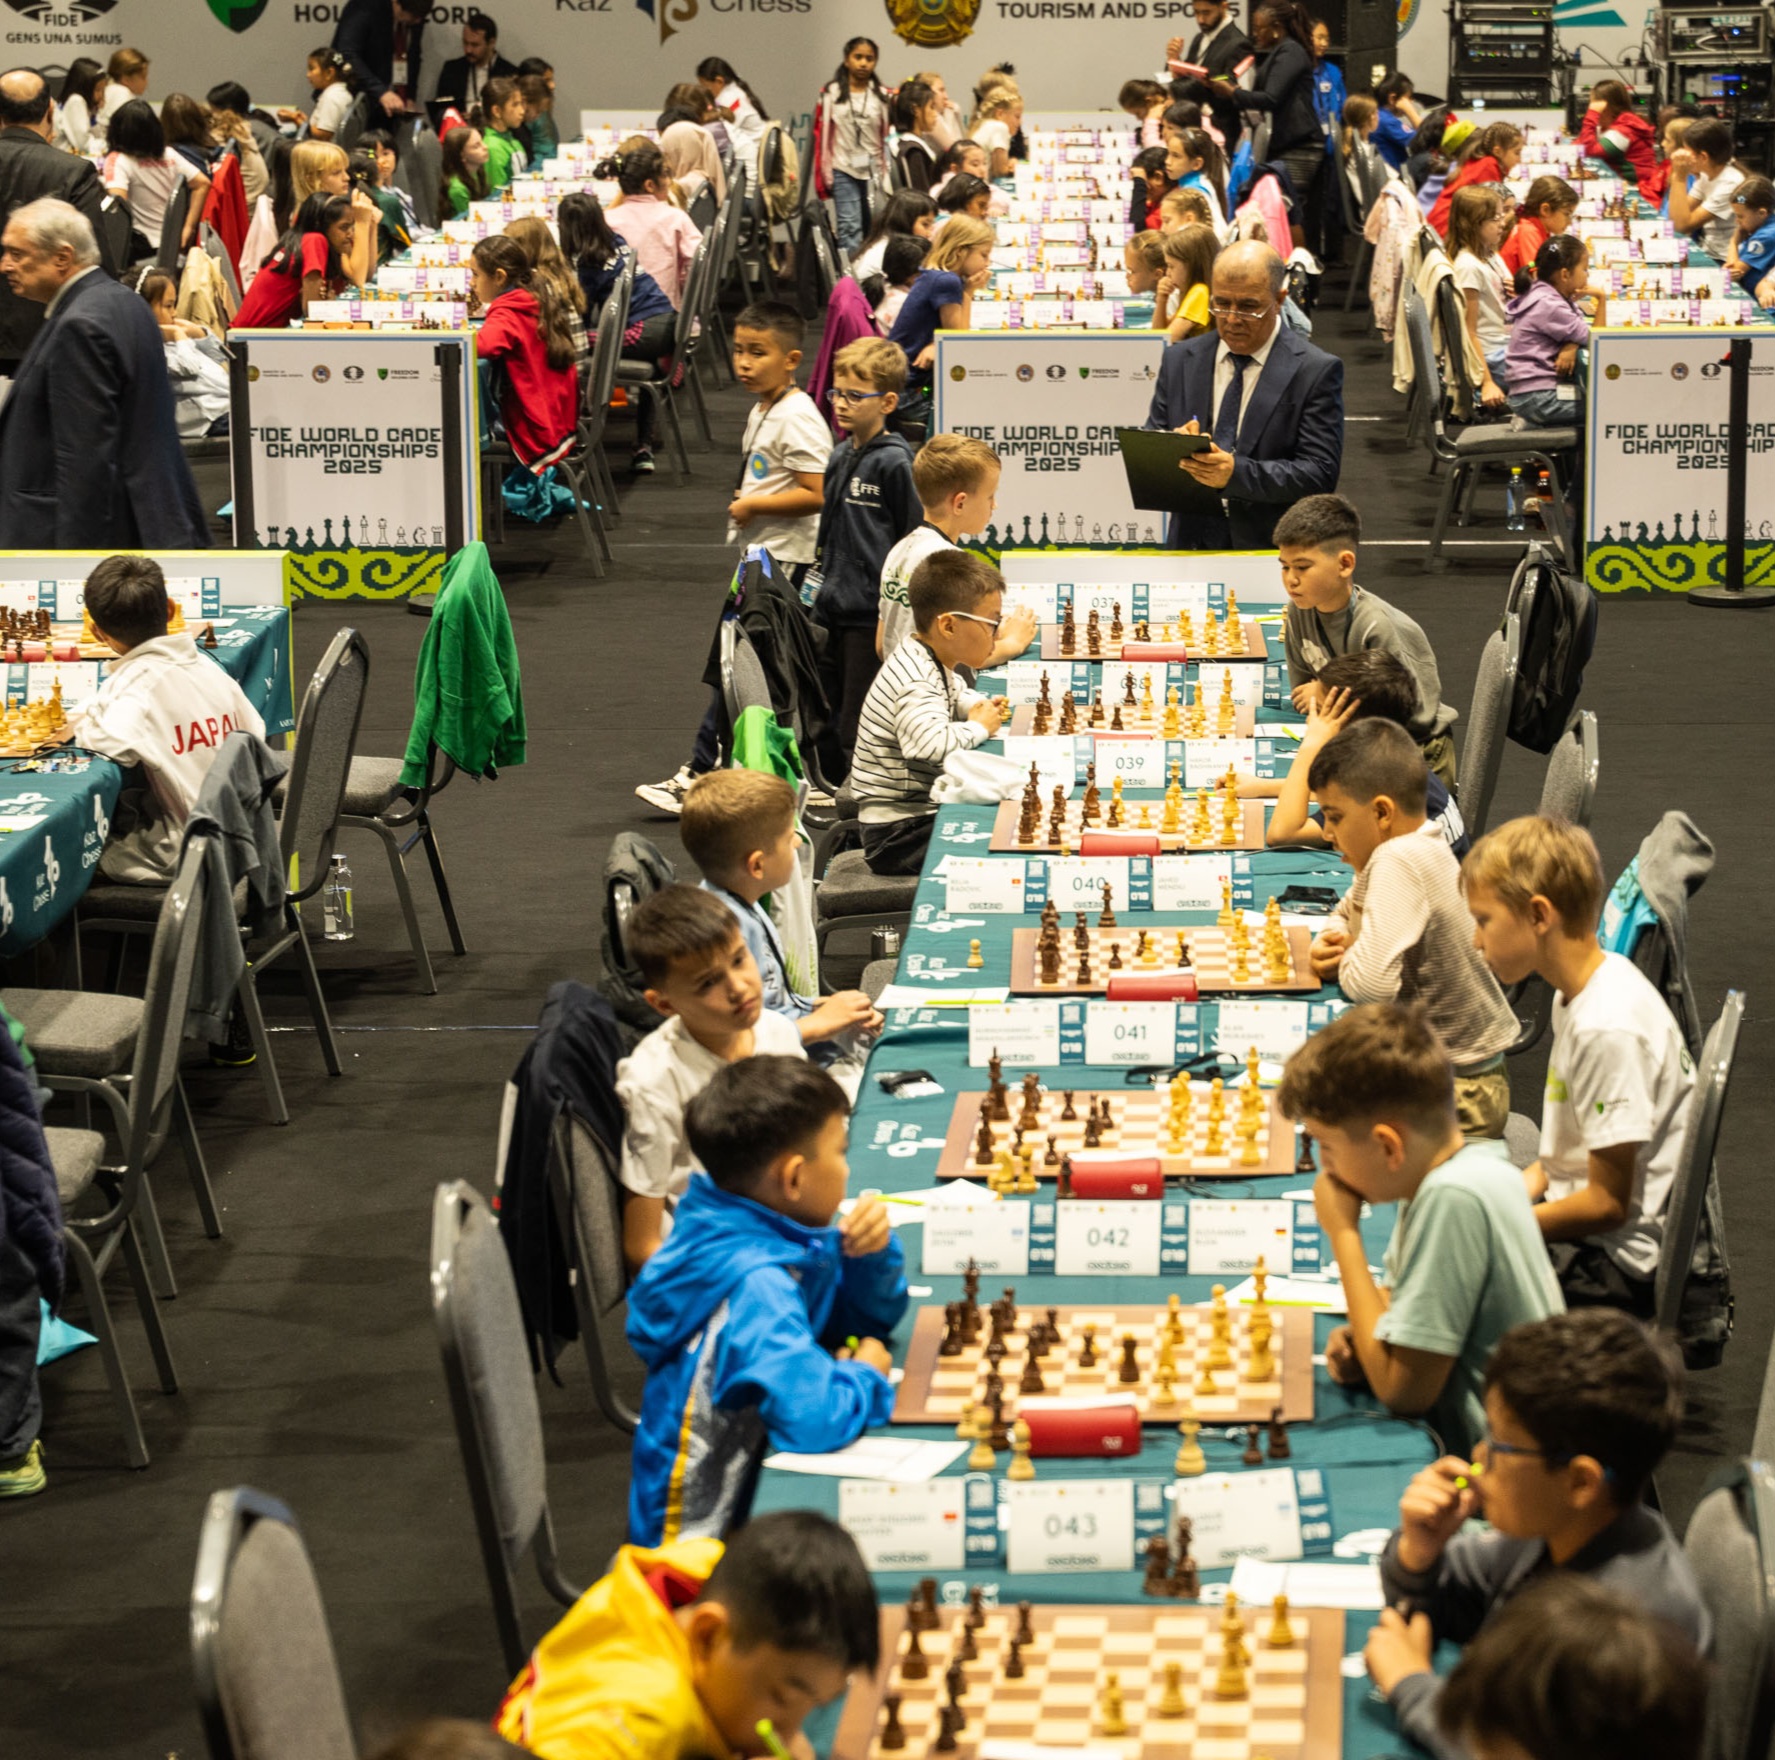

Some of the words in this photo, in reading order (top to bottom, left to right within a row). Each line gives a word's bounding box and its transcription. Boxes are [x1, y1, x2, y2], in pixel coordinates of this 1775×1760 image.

[424, 6, 481, 24] ORP
[996, 2, 1095, 19] TOURISM
[1101, 2, 1147, 19] AND
[1153, 2, 1240, 19] SPOS
[44, 13, 79, 27] FIDE
[6, 32, 41, 44] GENS
[44, 33, 73, 44] UNA
[75, 33, 123, 45] SUMUS
[301, 428, 378, 442] WORLD
[387, 428, 441, 442] CADE
[952, 426, 995, 440] FIDE
[1003, 426, 1078, 440] WORLD
[1605, 424, 1648, 439] FIDE
[1657, 424, 1730, 438] WORLD
[266, 443, 438, 458] CHAMPIONSHIPS
[990, 441, 1121, 456] HAMPIONSHIP
[1622, 439, 1774, 454] CHAMPIONHIP
[323, 460, 382, 474] 2025
[1024, 457, 1081, 471] 2025
[860, 483, 880, 496] FFE
[1091, 597, 1115, 608] 037
[171, 711, 239, 755] JAPA
[1115, 756, 1145, 770] 039
[1072, 876, 1107, 891] 040
[1113, 1024, 1147, 1040] 041
[1087, 1227, 1130, 1247] 042
[1043, 1512, 1098, 1539] 043
